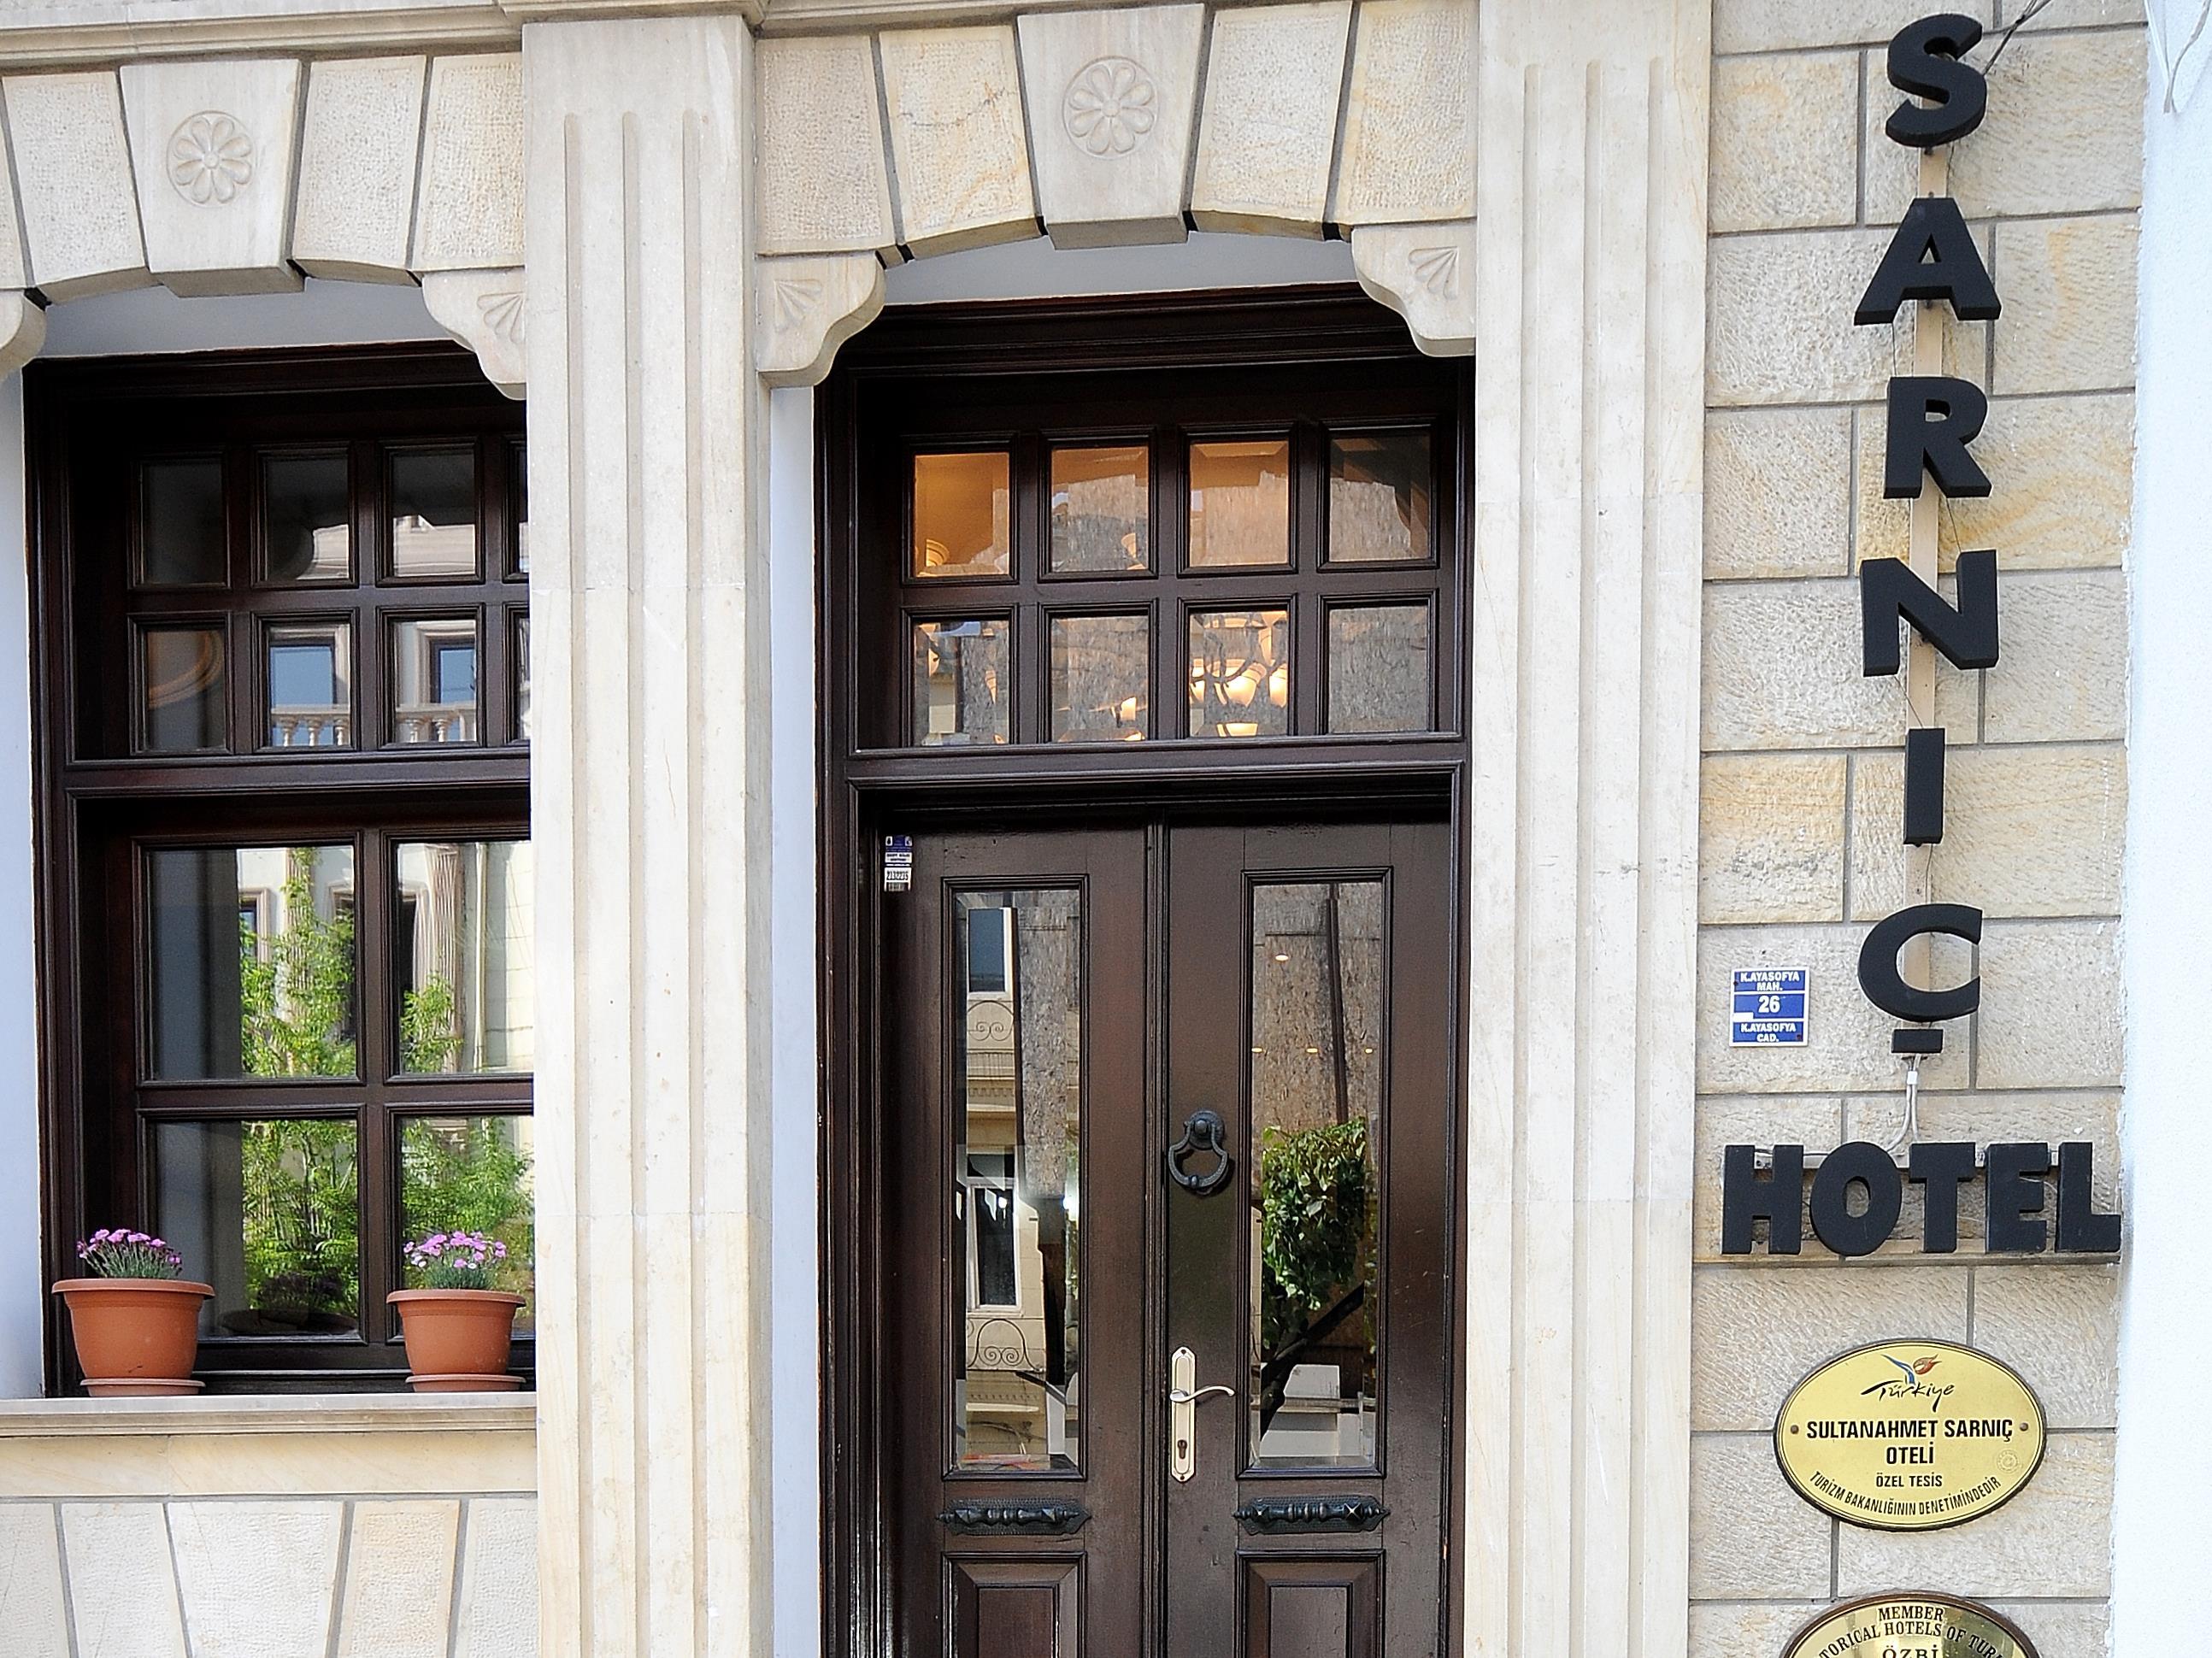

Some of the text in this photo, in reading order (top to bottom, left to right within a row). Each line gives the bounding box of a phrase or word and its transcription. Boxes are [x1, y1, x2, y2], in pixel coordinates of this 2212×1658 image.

[1854, 13, 2002, 1054] SARNIÇ
[1740, 972, 1800, 982] K.AYASOFYA
[1756, 982, 1783, 991] MAH.
[1758, 995, 1780, 1014] 26
[1740, 1023, 1796, 1032] K.AYASOFYA
[1756, 1033, 1780, 1043] CAD.
[1721, 1141, 2121, 1256] HOTEL
[1860, 1379, 1955, 1413] Türkiye
[1806, 1419, 2013, 1442] SULTANAHMET SARNIÇ
[1885, 1442, 1934, 1465] OTELİ
[1875, 1471, 1943, 1487] ÖZEL TESİS
[1809, 1471, 2002, 1515] TURİZM BAKANLIĞININ DENETİMİNDEDİR
[1878, 1606, 1944, 1621] MEMBER
[1884, 1621, 1942, 1637] HOTELS
[1946, 1626, 1967, 1643] OF
[1968, 1634, 2005, 1658] TUR
